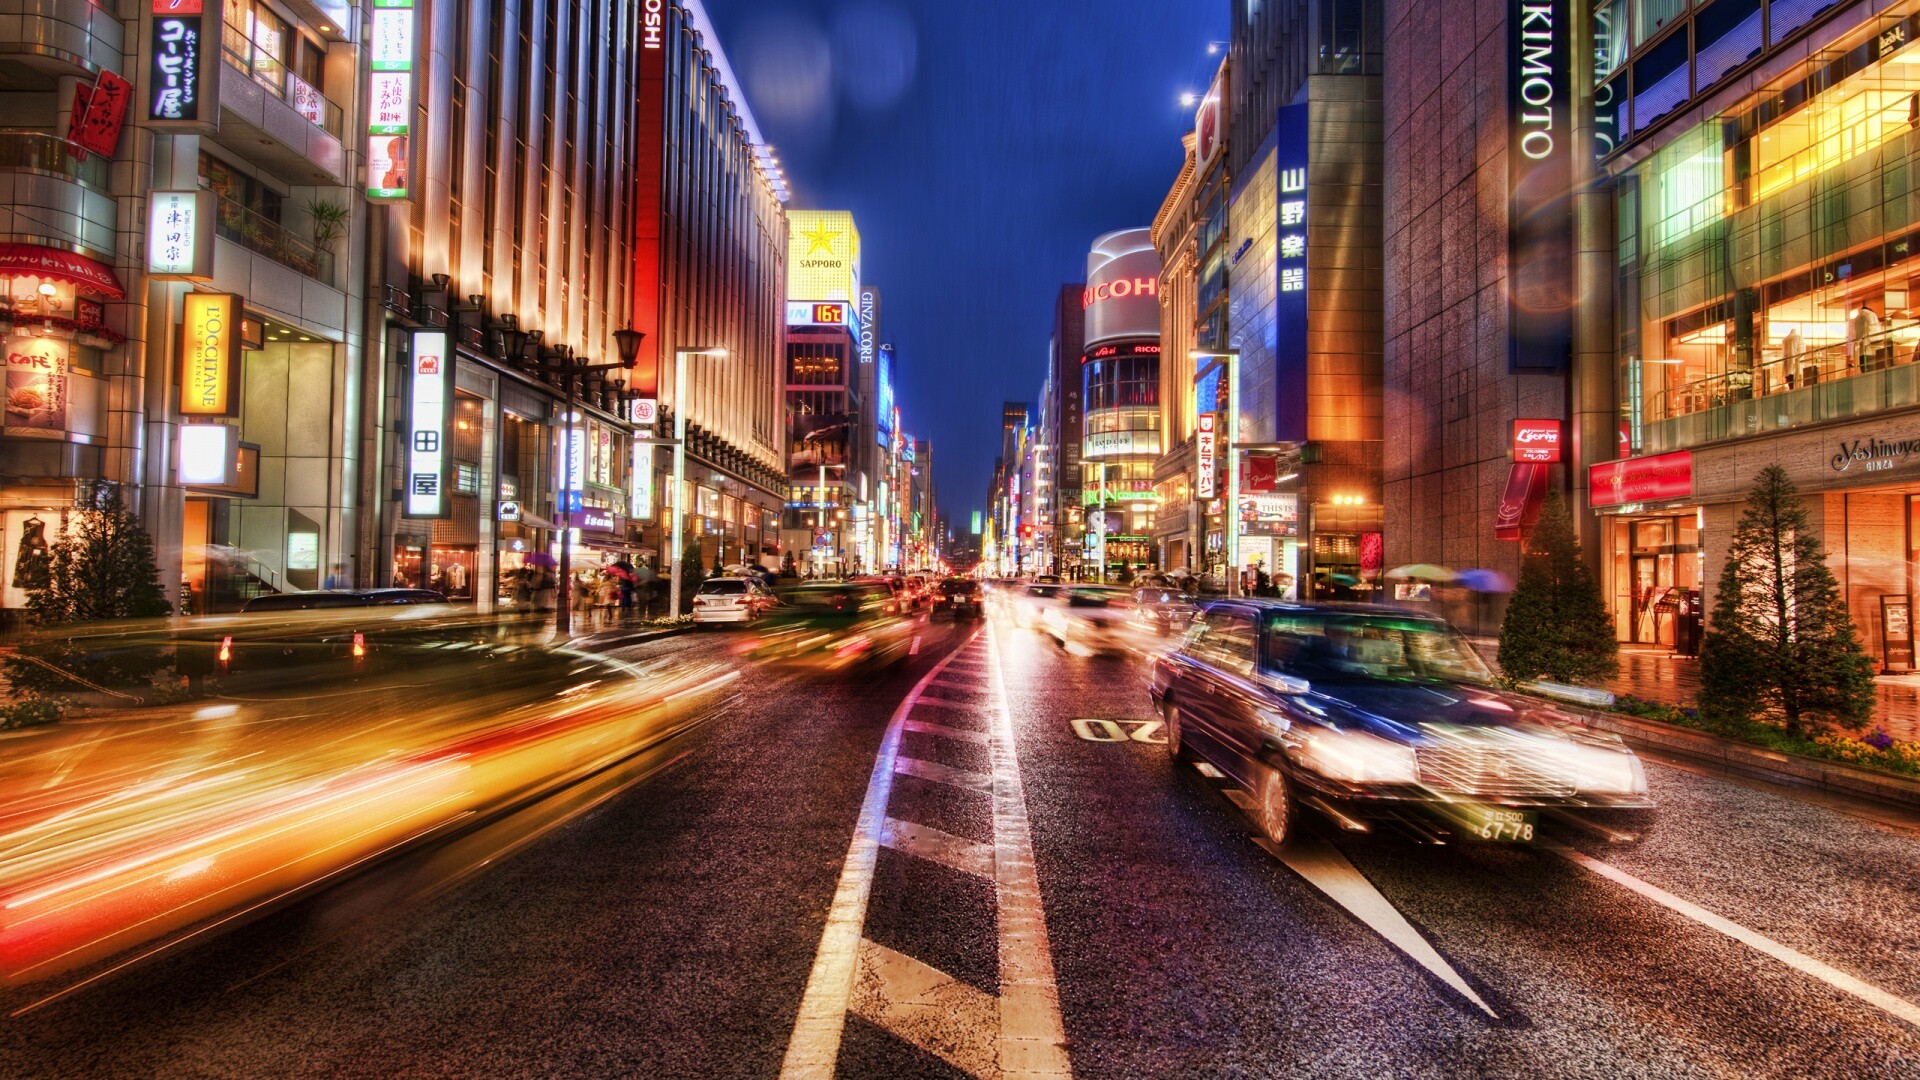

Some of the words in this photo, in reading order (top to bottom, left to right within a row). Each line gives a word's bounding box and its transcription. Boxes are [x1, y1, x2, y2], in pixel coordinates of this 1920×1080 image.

[154, 21, 185, 117] コーヒー屋
[1522, 4, 1553, 159] KIMOTO
[1282, 168, 1305, 291] 山野楽器
[800, 260, 842, 268] SAPPORO
[861, 292, 873, 330] GINZA
[1082, 278, 1156, 310] RICOH
[195, 341, 203, 388] PROVENCE
[860, 332, 873, 363] CORE
[413, 430, 439, 495] 田屋
[1201, 437, 1213, 493] キムラヤのパン
[1866, 460, 1893, 471] GINZA
[1482, 822, 1533, 840] 67-78
[1506, 812, 1524, 822] 500
